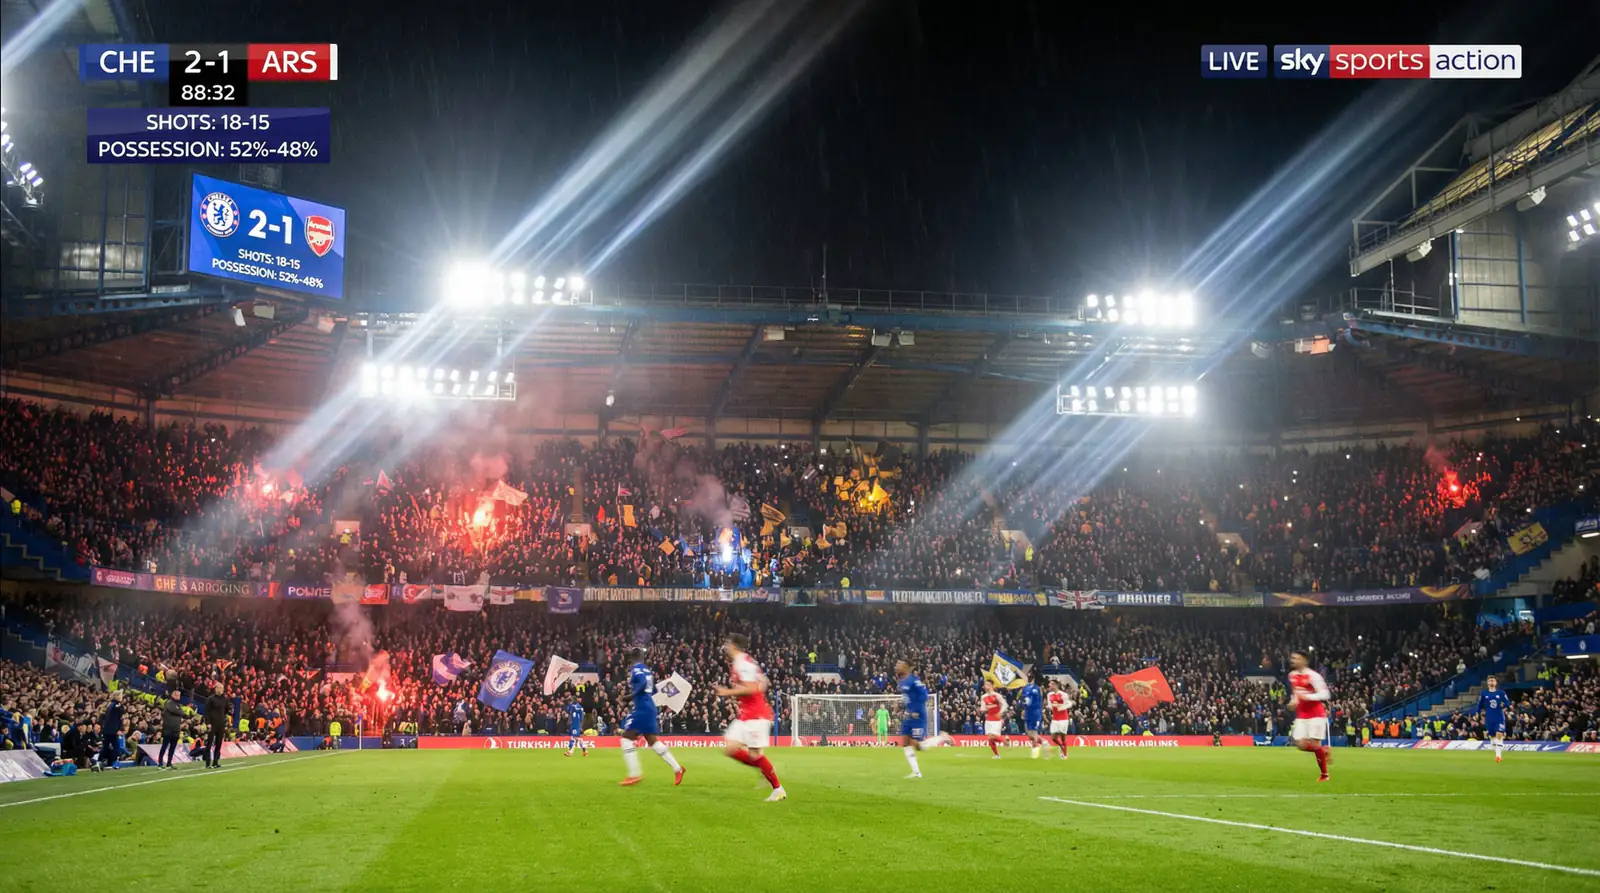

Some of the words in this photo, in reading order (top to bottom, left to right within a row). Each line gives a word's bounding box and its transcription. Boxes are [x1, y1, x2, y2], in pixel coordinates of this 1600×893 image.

[248, 209, 293, 245] 2-1
[238, 249, 274, 264] SHOTS:
[276, 256, 301, 270] 18-15
[212, 258, 277, 280] POSSESSION:
[279, 271, 324, 288] 52%-48%
[664, 740, 707, 748] TURKISH
